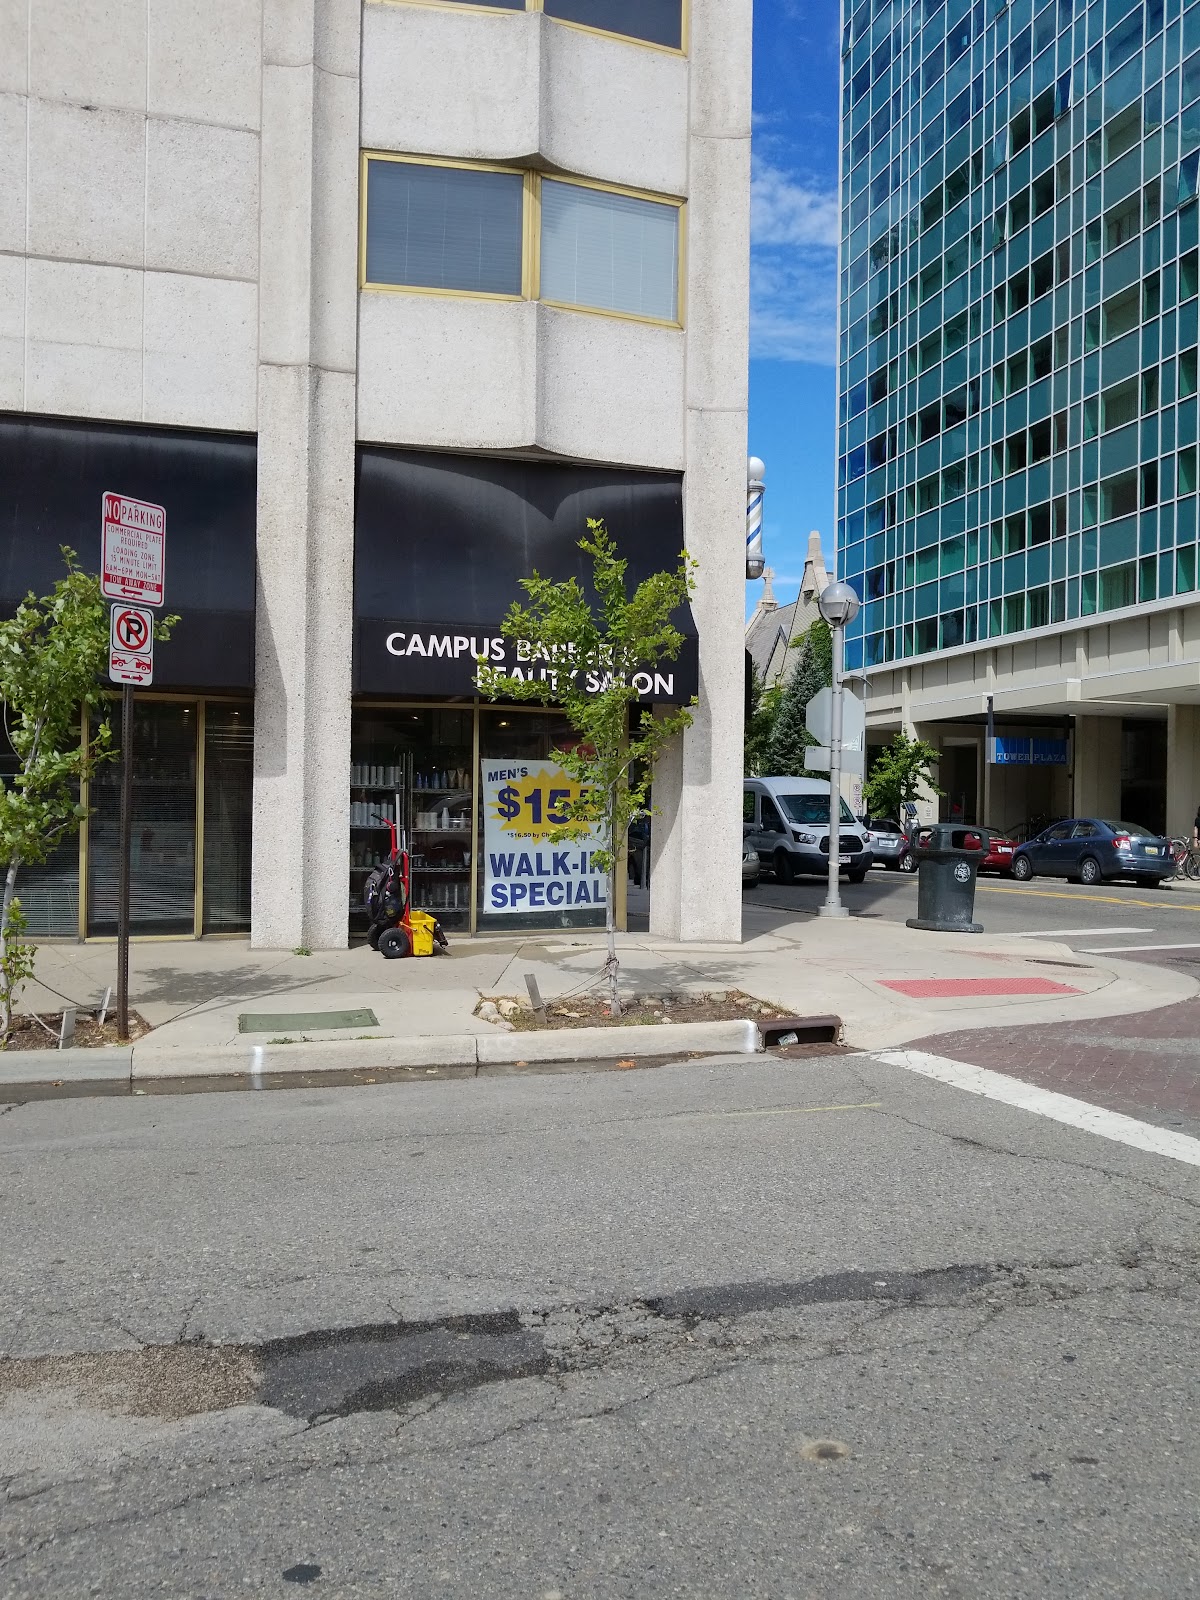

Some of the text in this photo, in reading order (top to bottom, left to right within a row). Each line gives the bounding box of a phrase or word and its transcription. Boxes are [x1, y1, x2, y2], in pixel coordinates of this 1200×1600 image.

[106, 498, 161, 528] NO PARKING
[107, 524, 162, 545] COMMERCIAL PLATE
[120, 536, 148, 550] REQUIRED
[111, 554, 157, 571] 15 MINUTE LIMIT
[113, 546, 155, 562] LOADING ZONE
[109, 574, 157, 592] TOW AWAY ZONE
[135, 570, 161, 582] MON-SAT
[386, 632, 505, 661] CAMPUS
[996, 752, 1067, 761] TOWER PLAZA
[488, 767, 529, 782] MEN'S
[491, 880, 607, 909] SPECIAL
